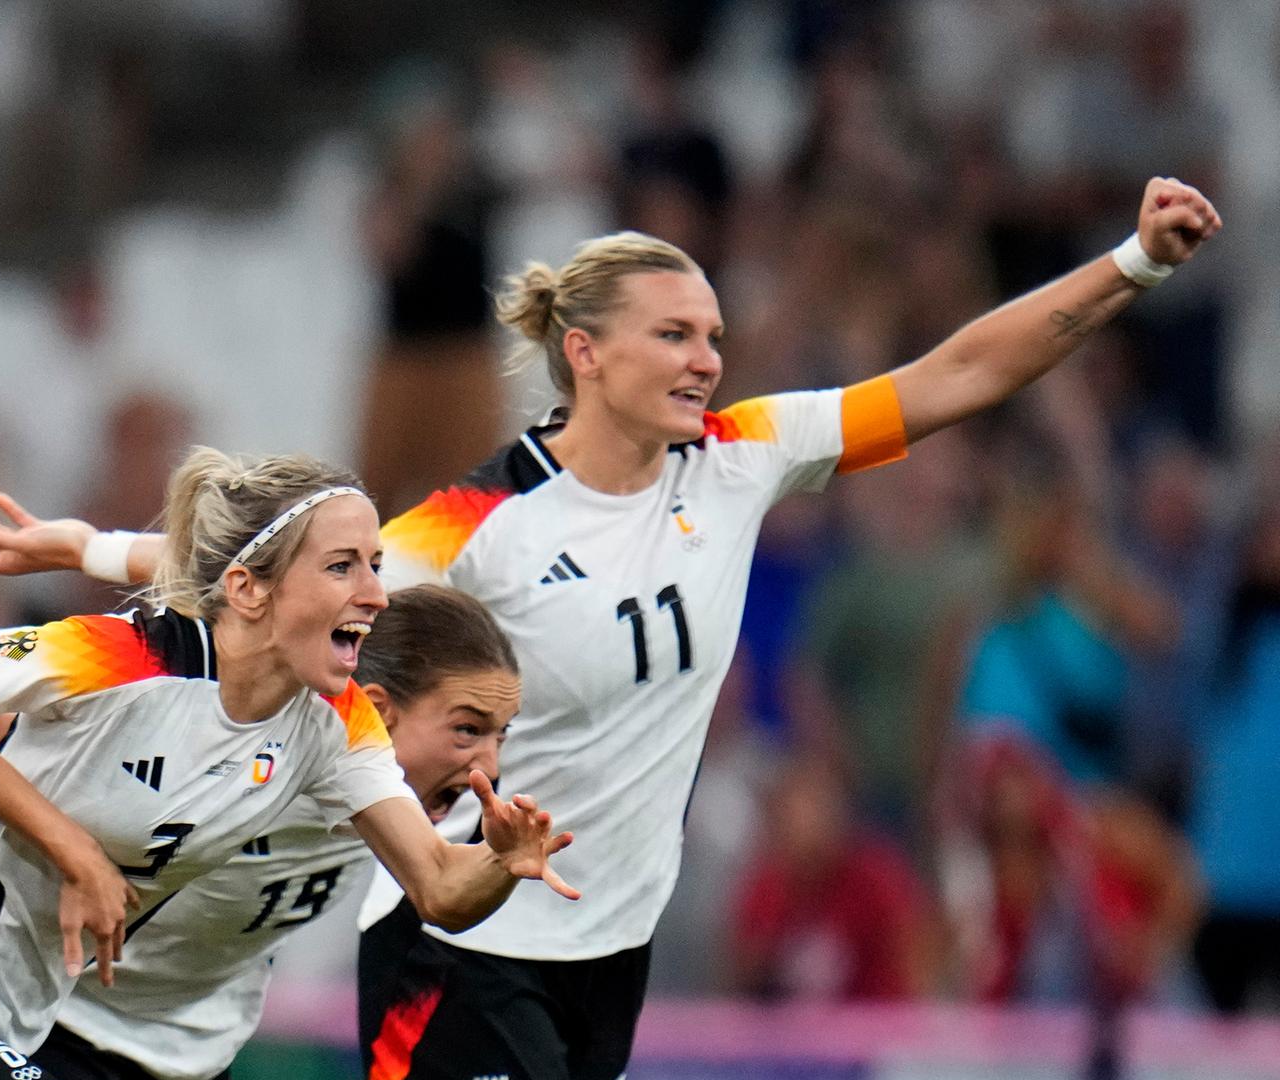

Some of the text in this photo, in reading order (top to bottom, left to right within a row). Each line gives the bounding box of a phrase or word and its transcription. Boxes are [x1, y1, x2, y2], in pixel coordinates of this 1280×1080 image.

[616, 583, 697, 687] 11
[253, 752, 274, 785] D
[119, 823, 197, 880] 3
[239, 865, 345, 935] 19
